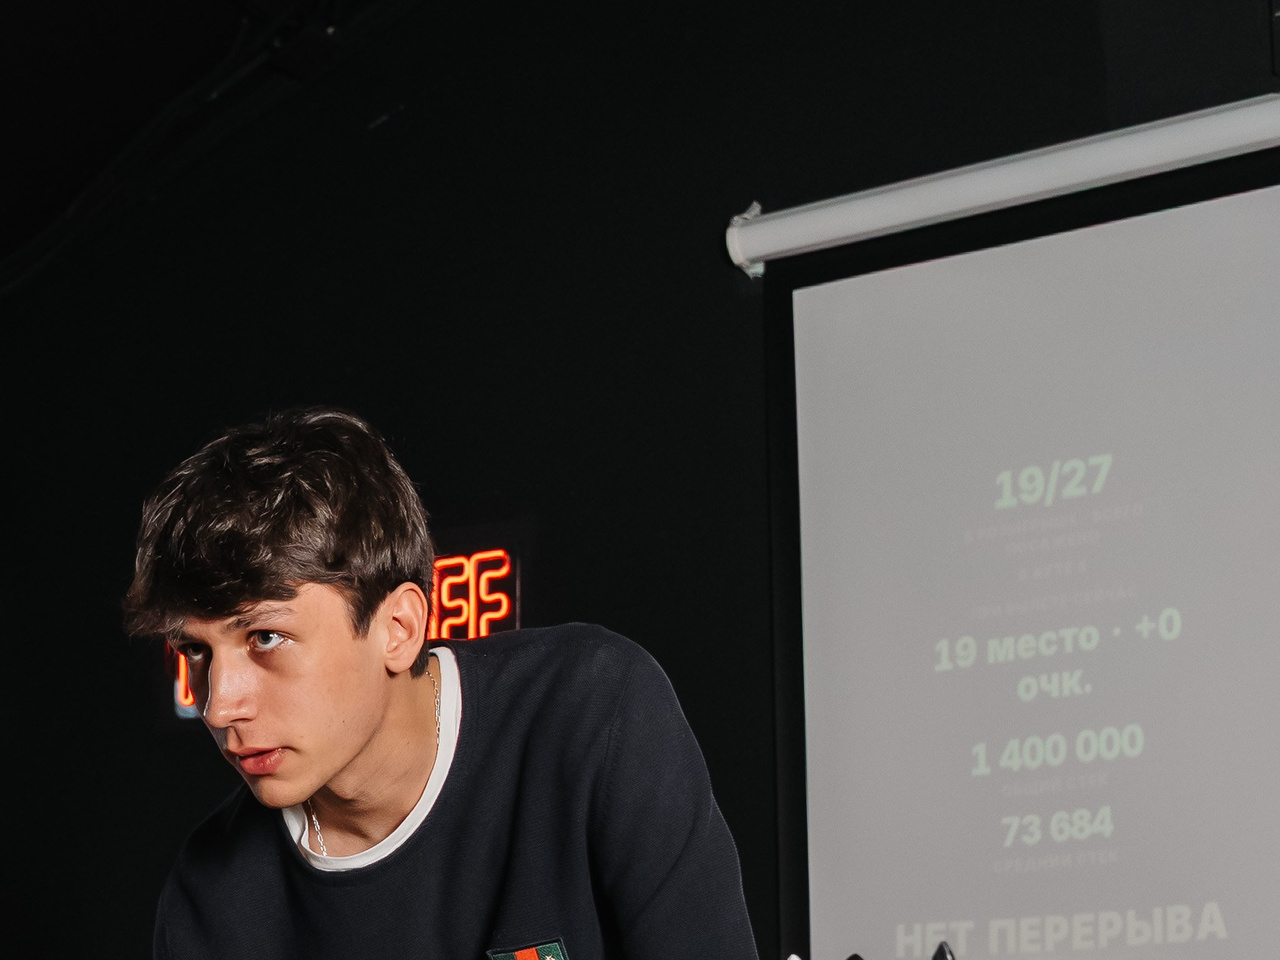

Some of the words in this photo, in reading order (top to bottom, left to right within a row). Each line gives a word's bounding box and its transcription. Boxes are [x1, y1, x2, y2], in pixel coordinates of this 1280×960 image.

[995, 453, 1113, 510] 19/27
[934, 635, 977, 672] 19
[987, 625, 1100, 664] место
[1135, 608, 1182, 641] +0
[1017, 669, 1093, 702] очк.
[970, 742, 991, 776] 1
[999, 733, 1067, 771] 400
[1075, 723, 1144, 762] 000
[1000, 814, 1042, 848] 73
[1050, 804, 1114, 843] 684
[896, 921, 974, 959] НЕТ
[989, 902, 1227, 954] ПЕРЕРЫВА
